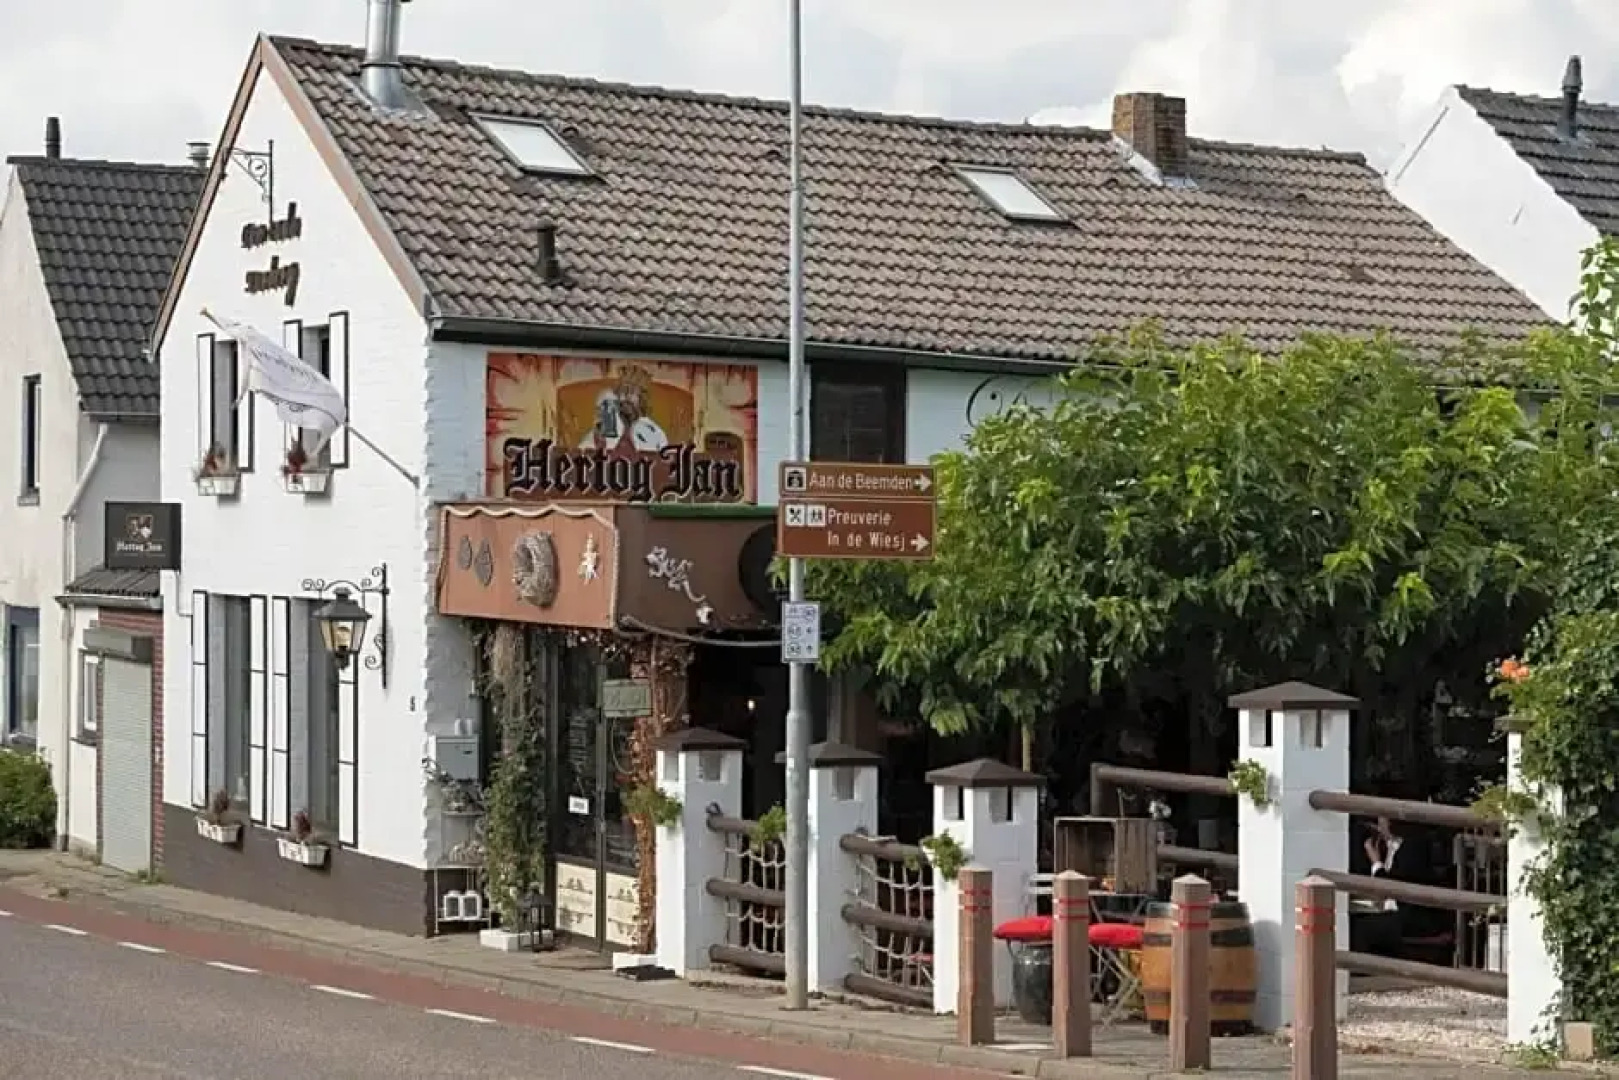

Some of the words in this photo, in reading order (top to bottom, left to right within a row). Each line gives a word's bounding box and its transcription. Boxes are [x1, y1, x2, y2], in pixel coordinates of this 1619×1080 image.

[503, 436, 654, 503] Hertog
[660, 442, 744, 503] Jan
[809, 472, 834, 489] Aan
[838, 473, 852, 488] de
[855, 474, 912, 490] Beemden
[827, 508, 891, 525] Preuverie
[847, 532, 863, 547] de
[869, 532, 905, 551] Wiesj
